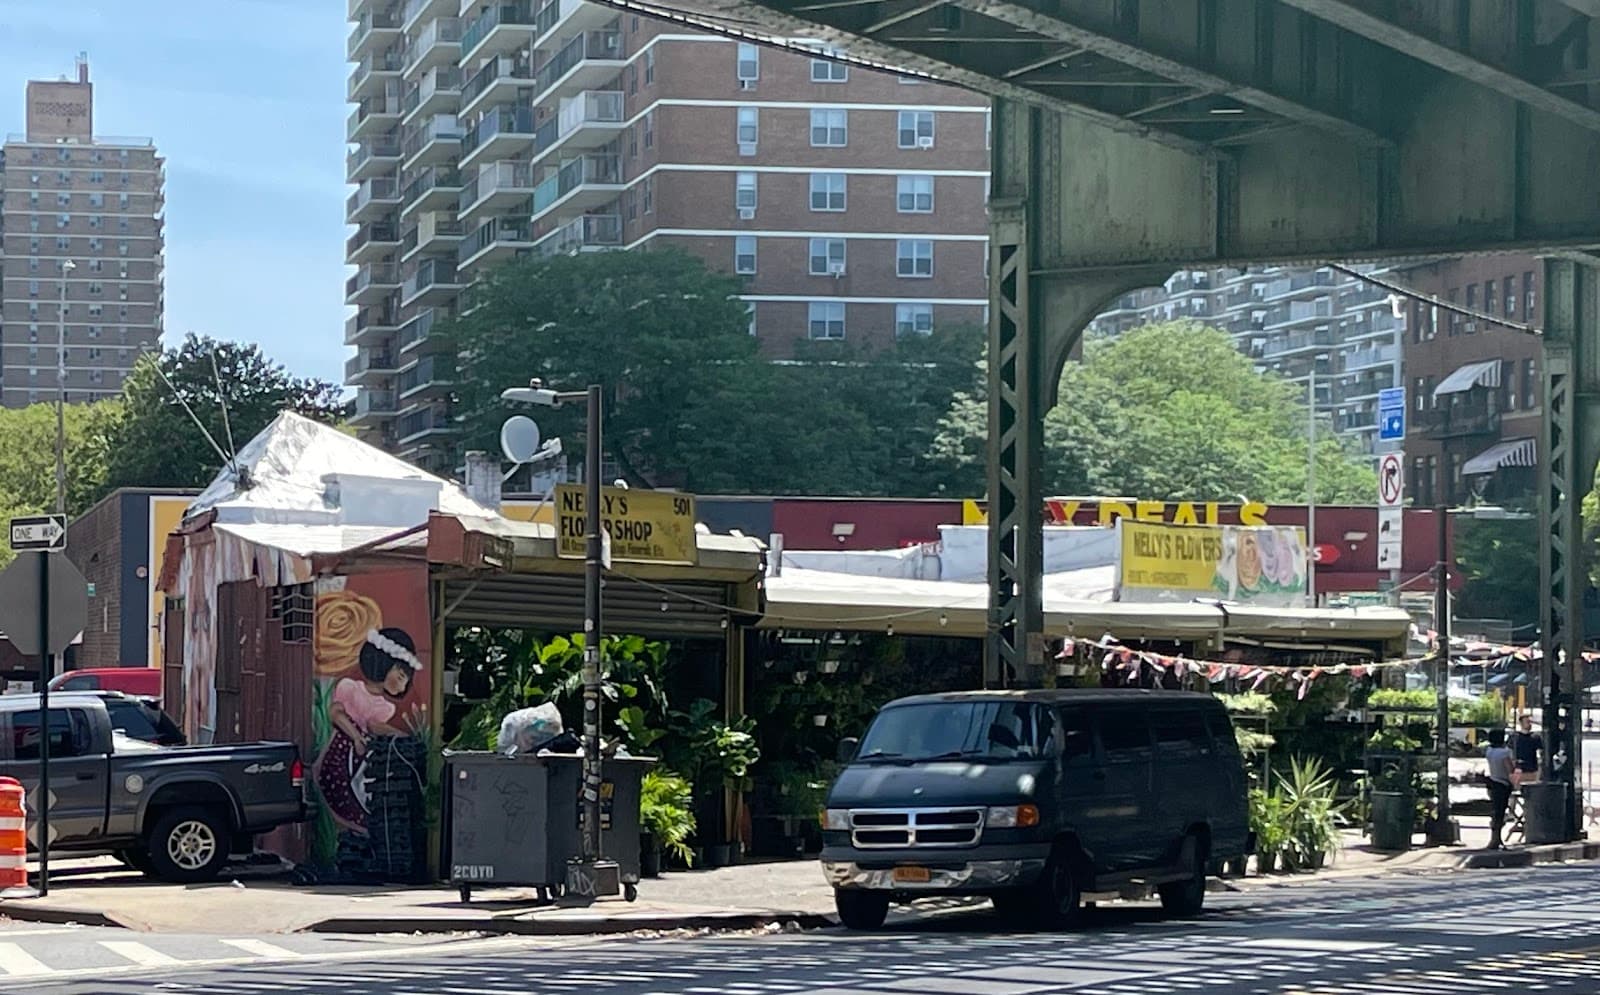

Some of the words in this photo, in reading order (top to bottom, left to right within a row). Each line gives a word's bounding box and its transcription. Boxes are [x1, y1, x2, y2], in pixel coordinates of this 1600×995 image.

[563, 492, 628, 516] NEY'S
[674, 497, 691, 516] 501
[1099, 500, 1269, 528] DEALS
[15, 527, 32, 540] ONE
[42, 526, 60, 537] WAY
[561, 516, 613, 540] FLOR
[615, 520, 653, 541] SHOP
[1134, 531, 1171, 560] NELLY'S
[1175, 534, 1223, 562] FLOWERS
[244, 761, 287, 774] 4x4
